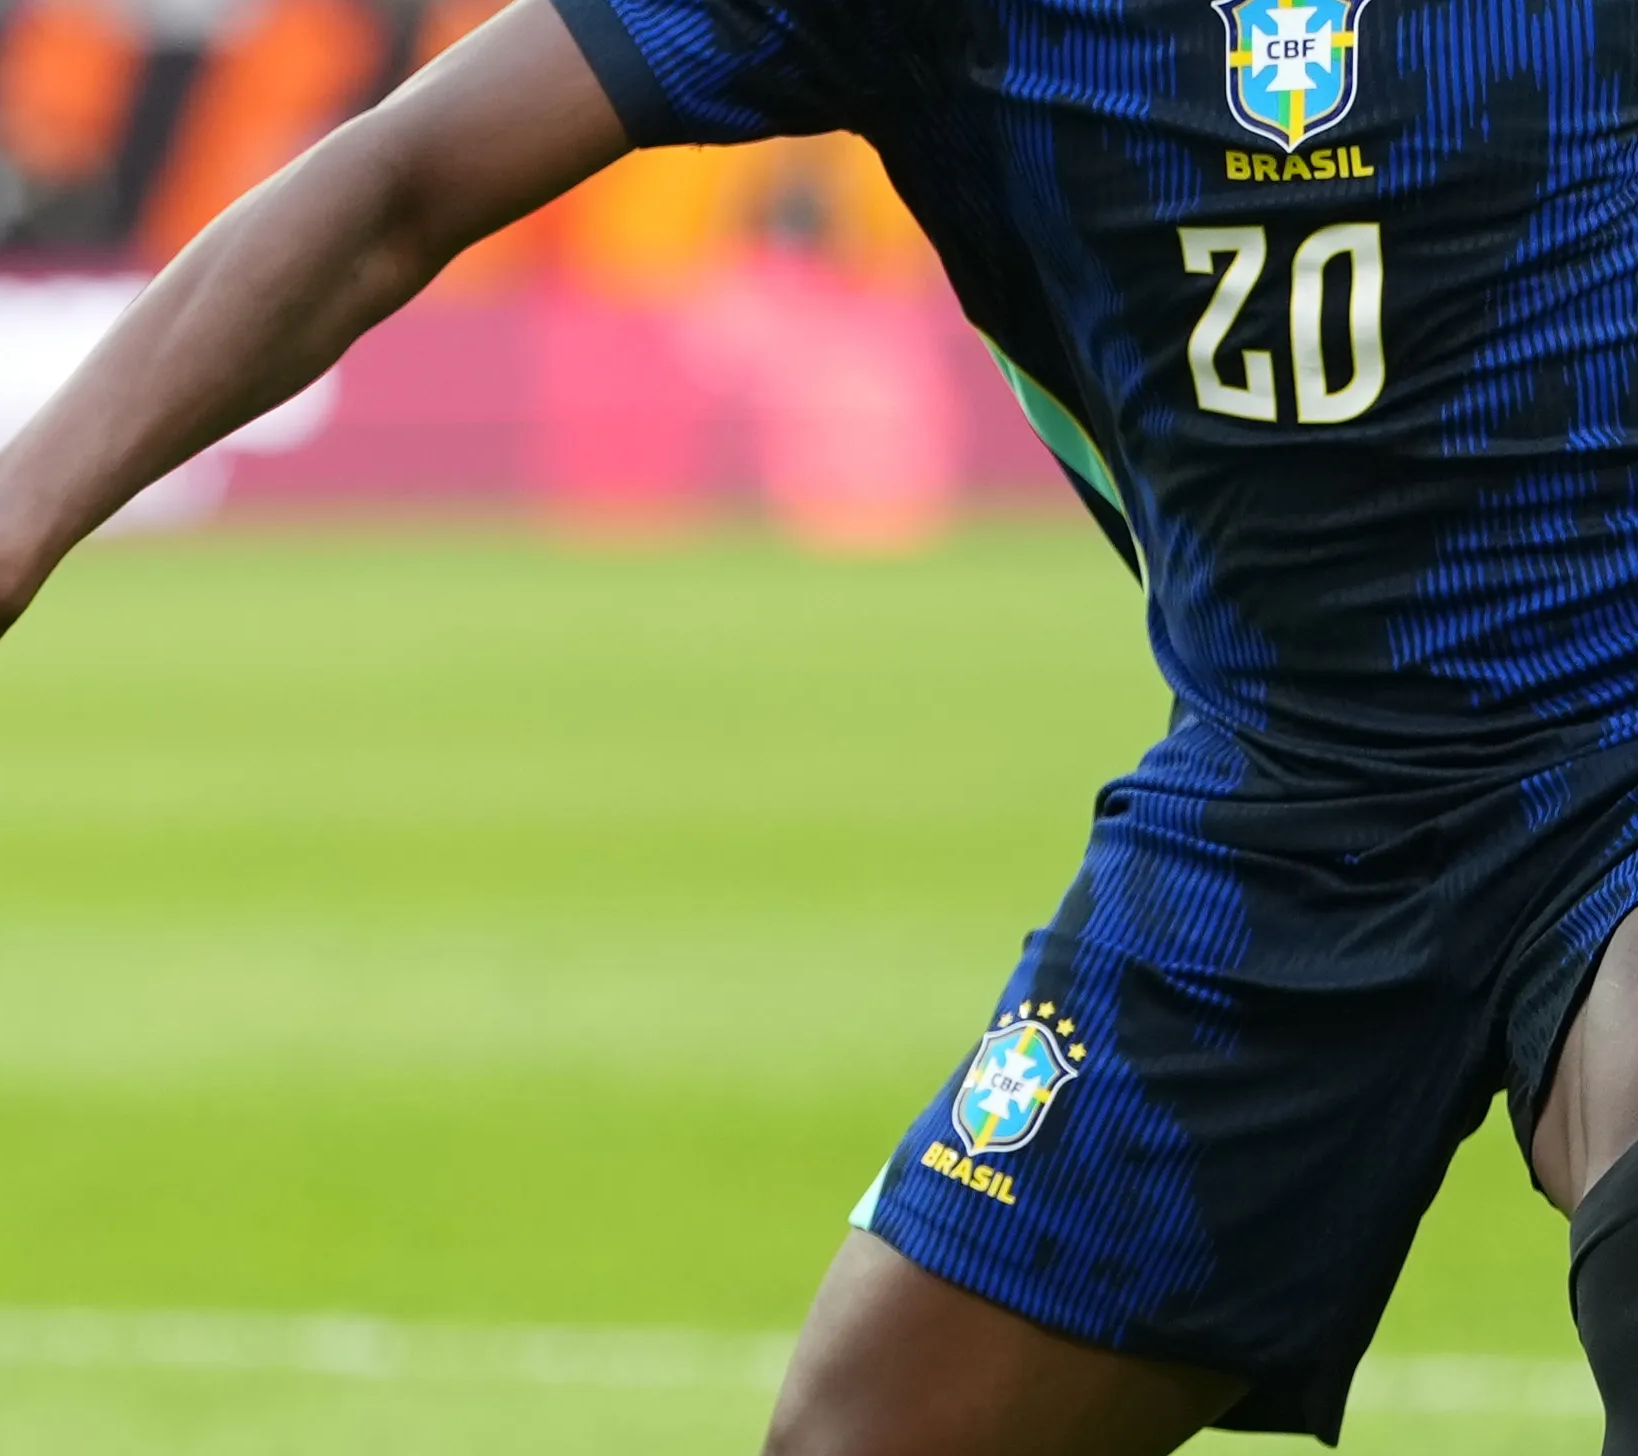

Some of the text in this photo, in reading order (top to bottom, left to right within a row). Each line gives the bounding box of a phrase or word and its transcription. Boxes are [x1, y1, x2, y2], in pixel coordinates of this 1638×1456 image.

[1267, 38, 1316, 60] CBF
[1225, 145, 1374, 182] BRASIL
[1177, 222, 1385, 424] 20
[990, 1073, 1024, 1095] CBF
[921, 1140, 1016, 1205] BRASIL
